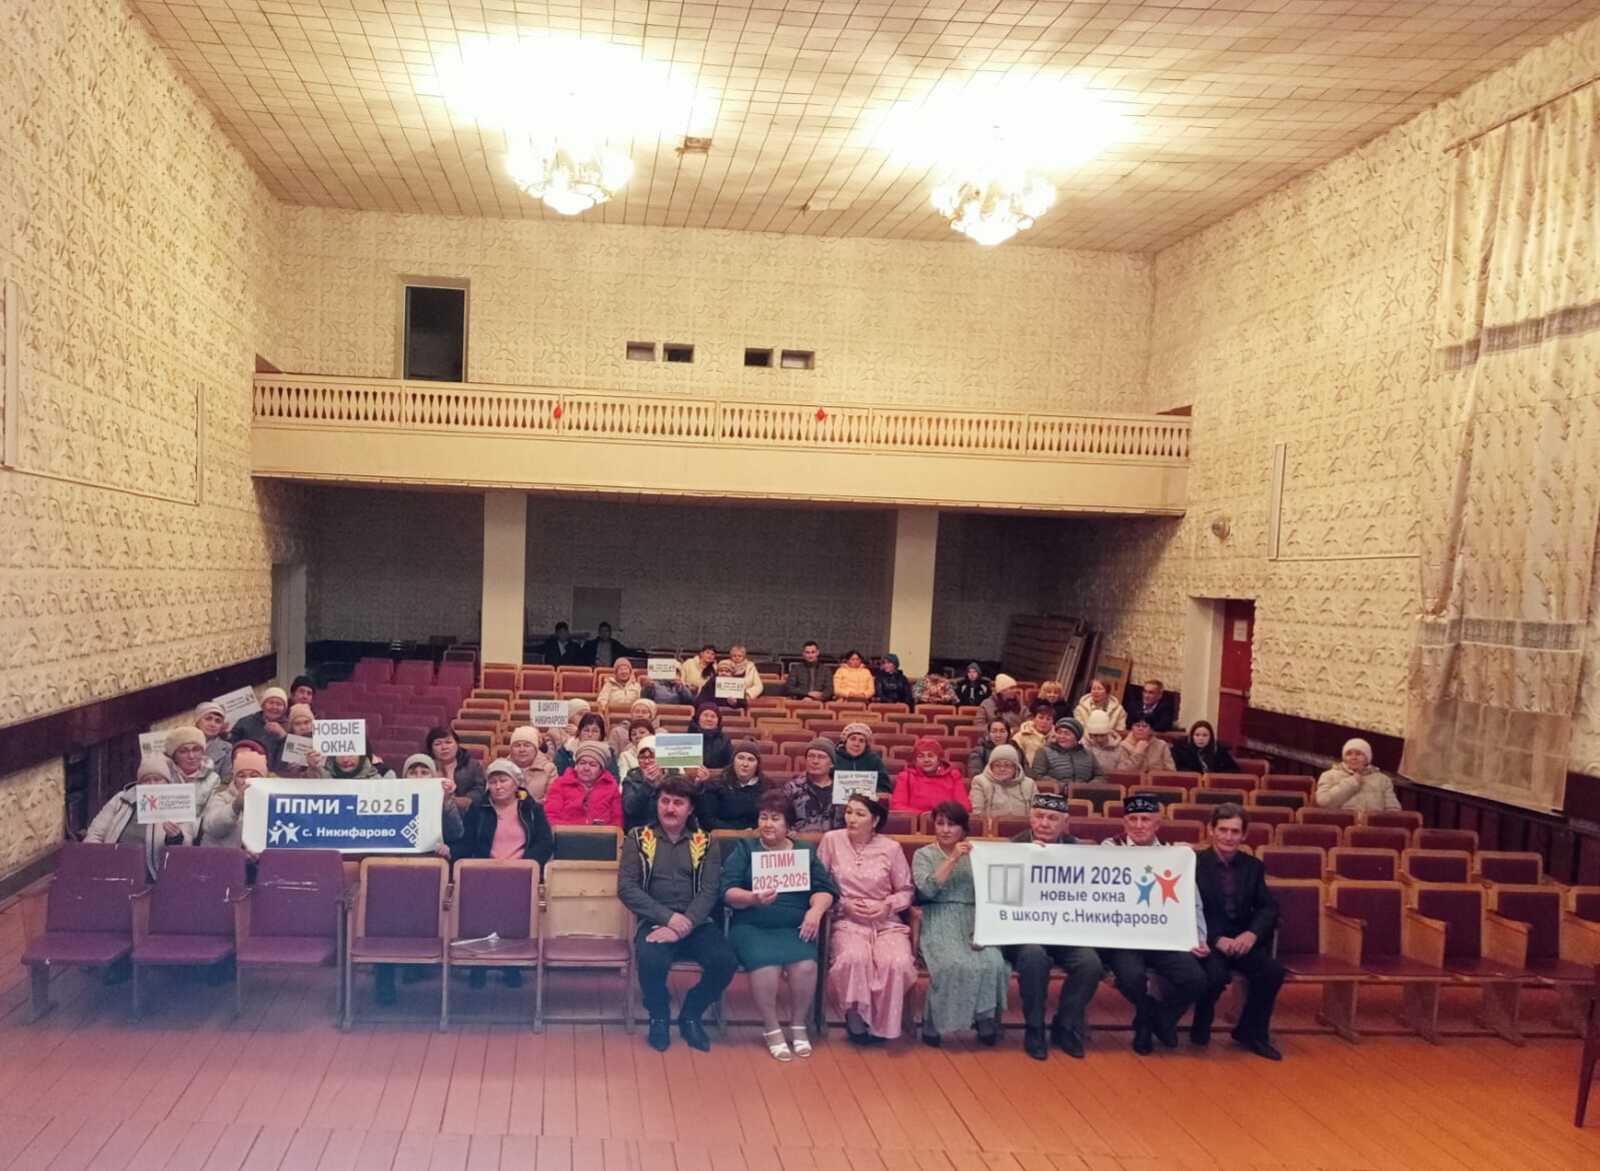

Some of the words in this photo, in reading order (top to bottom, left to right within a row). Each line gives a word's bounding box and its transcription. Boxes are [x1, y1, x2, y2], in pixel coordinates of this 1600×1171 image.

[313, 722, 360, 735] НОВЫЕ
[320, 740, 356, 753] ОКНА
[275, 798, 340, 814] ППМИ
[358, 798, 406, 814] 2026
[302, 829, 312, 838] с.
[316, 826, 396, 840] Никифарово
[760, 852, 796, 869] ППМИ
[753, 872, 809, 890] 2025-2026
[1030, 865, 1085, 885] ППМИ
[1090, 866, 1132, 886] 2026
[1040, 890, 1088, 902] новые
[1092, 892, 1126, 903] окна
[1000, 911, 1008, 921] в
[1012, 911, 1058, 926] школу
[1062, 908, 1168, 928] с.Никифарово
